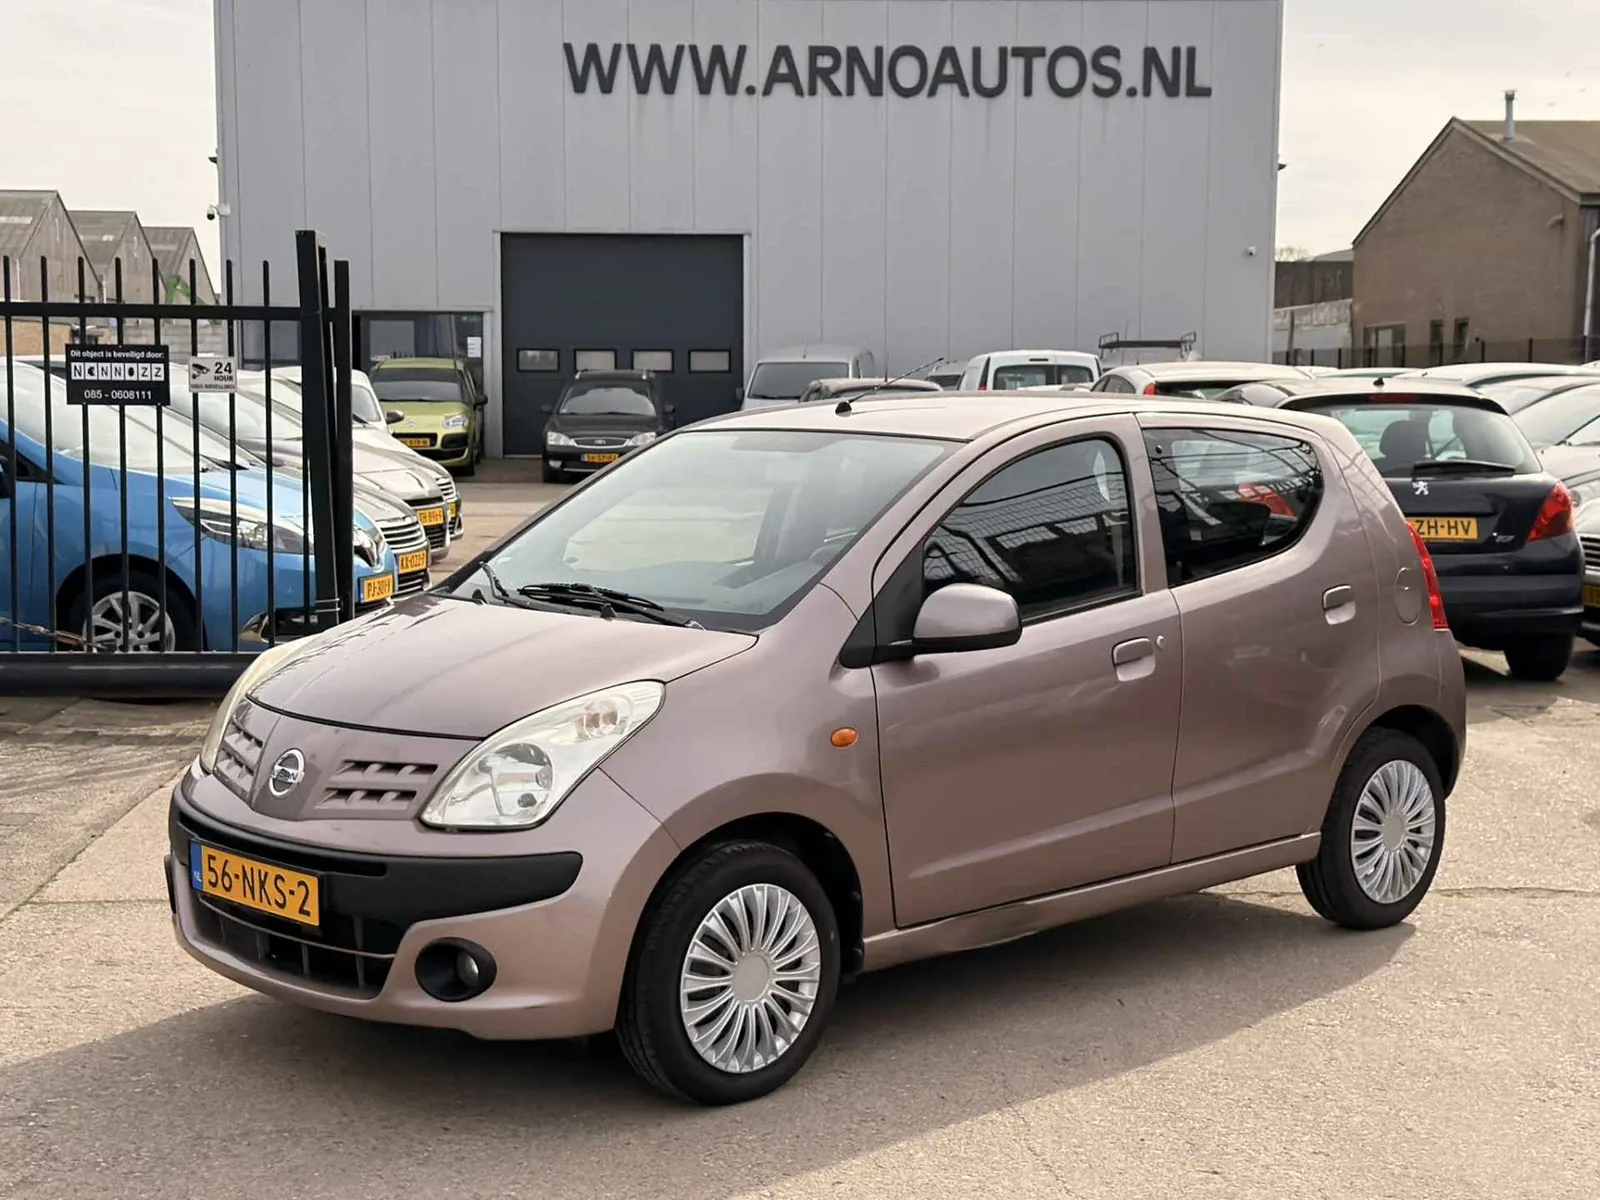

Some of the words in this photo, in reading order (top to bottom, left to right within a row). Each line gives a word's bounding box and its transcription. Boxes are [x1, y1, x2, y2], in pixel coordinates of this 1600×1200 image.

[563, 42, 1212, 98] WWW.ARNOAUTOS.NL
[82, 350, 104, 359] object
[113, 350, 145, 359] beveiligd
[214, 361, 233, 374] 24
[84, 389, 102, 399] 085
[1414, 520, 1472, 536] ZH-HV
[206, 853, 312, 918] 56-NKS-2
